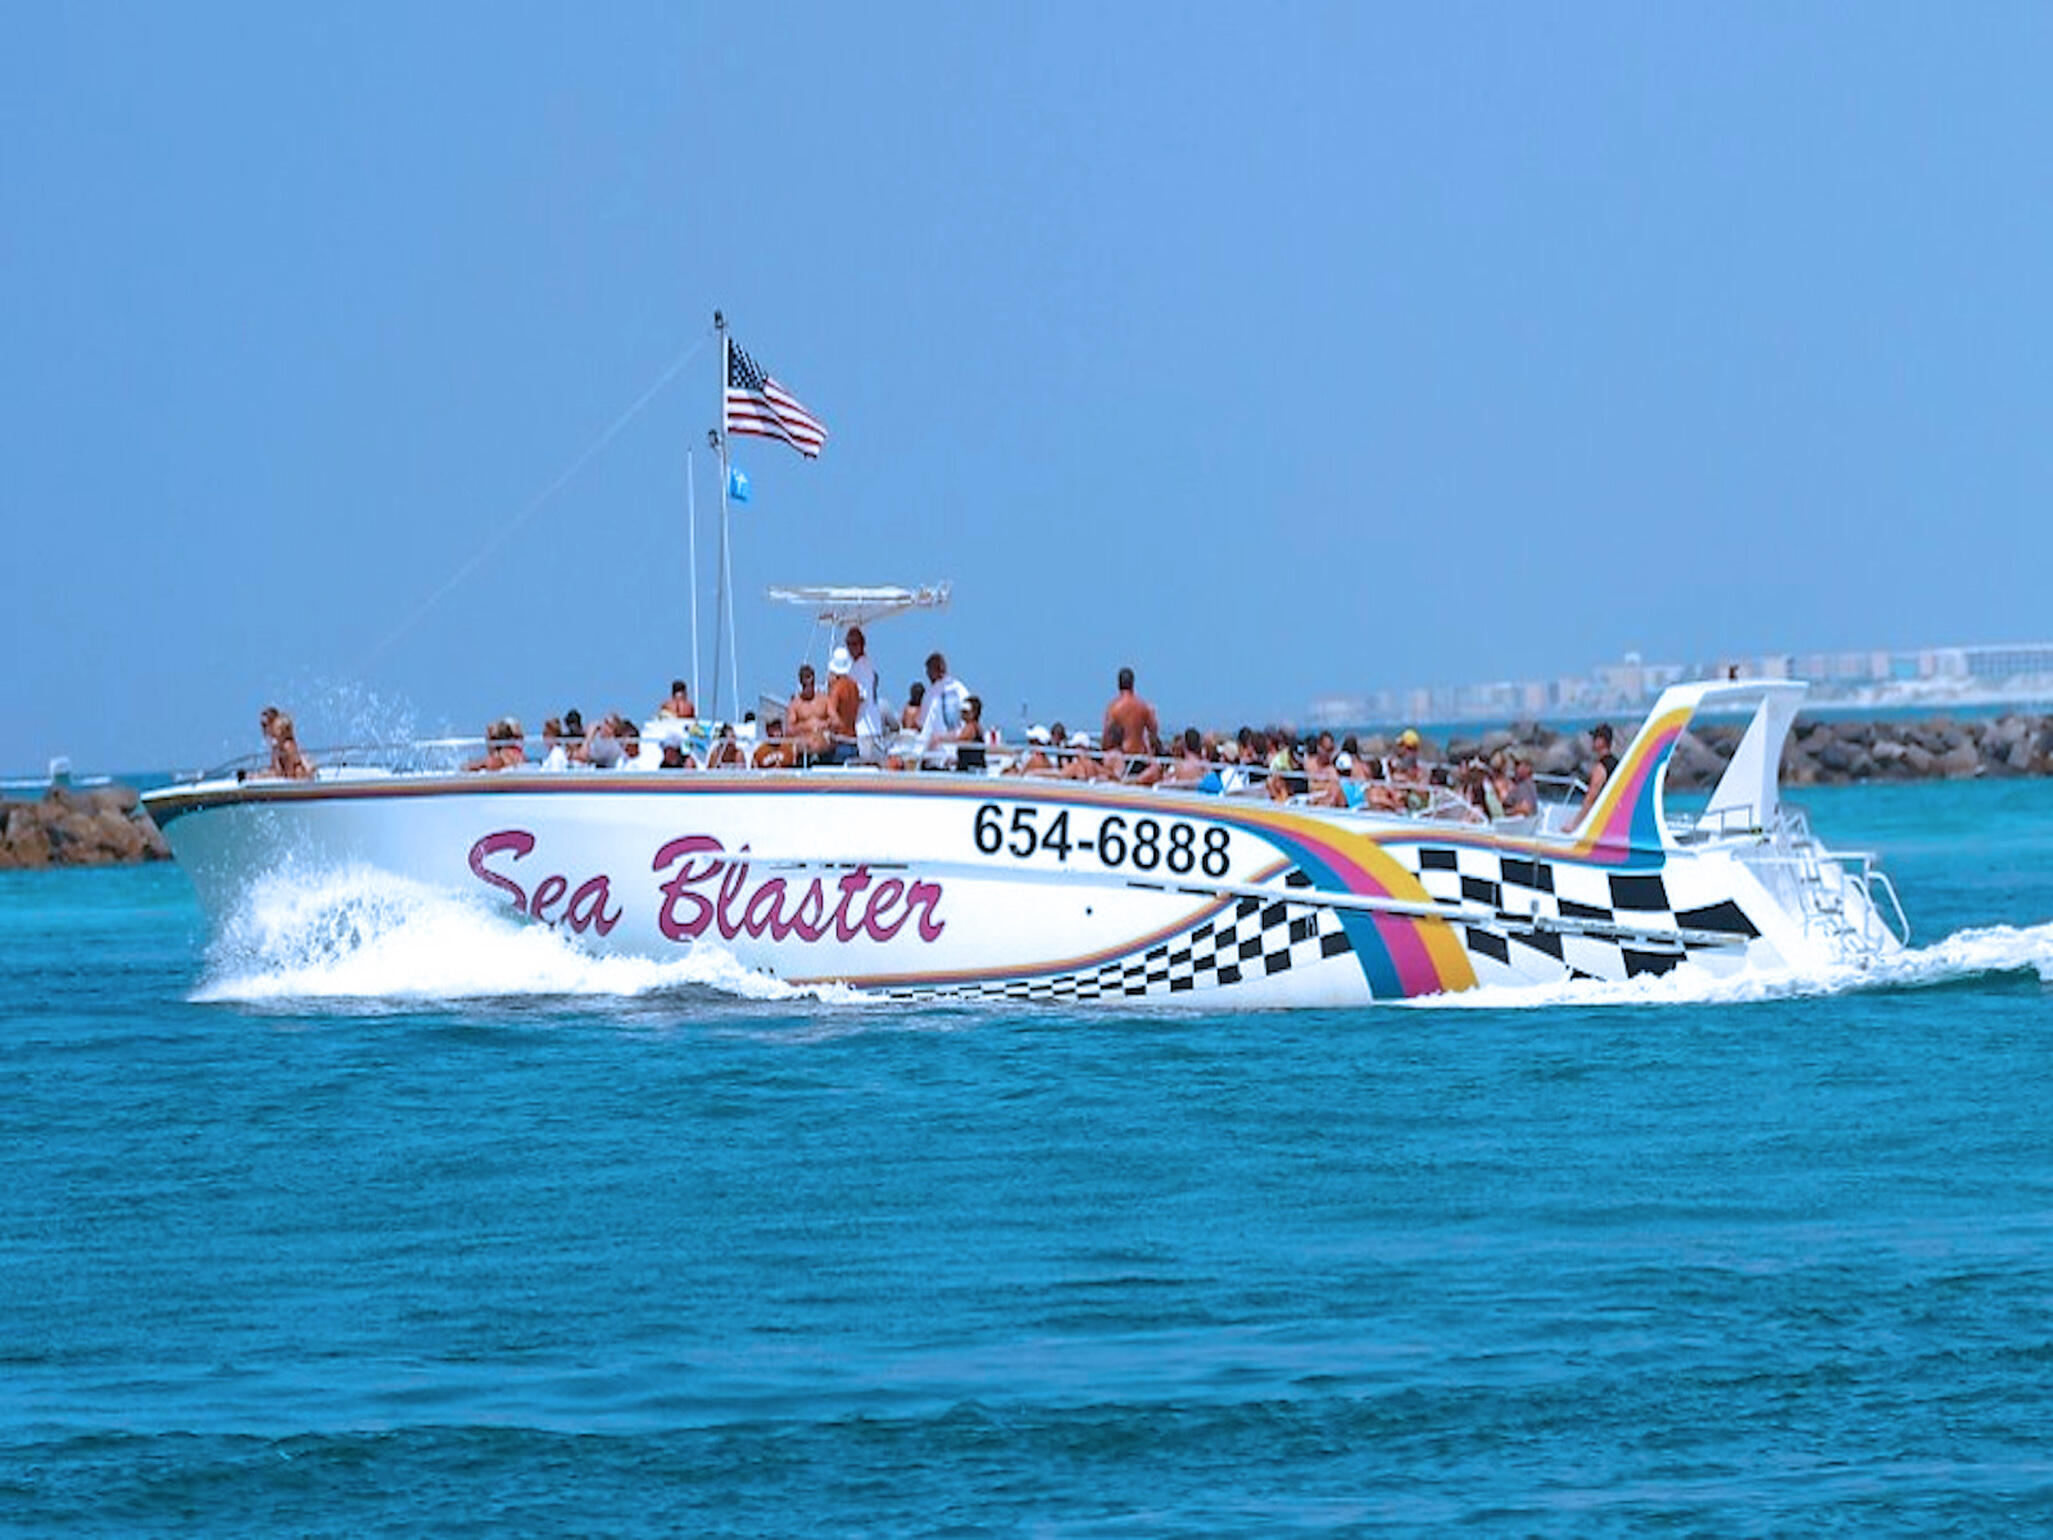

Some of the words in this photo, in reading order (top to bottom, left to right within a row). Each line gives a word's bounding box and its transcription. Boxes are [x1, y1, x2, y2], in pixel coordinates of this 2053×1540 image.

[467, 829, 623, 938] Sea
[652, 834, 946, 943] Blaster
[974, 803, 1231, 877] 654-6888
